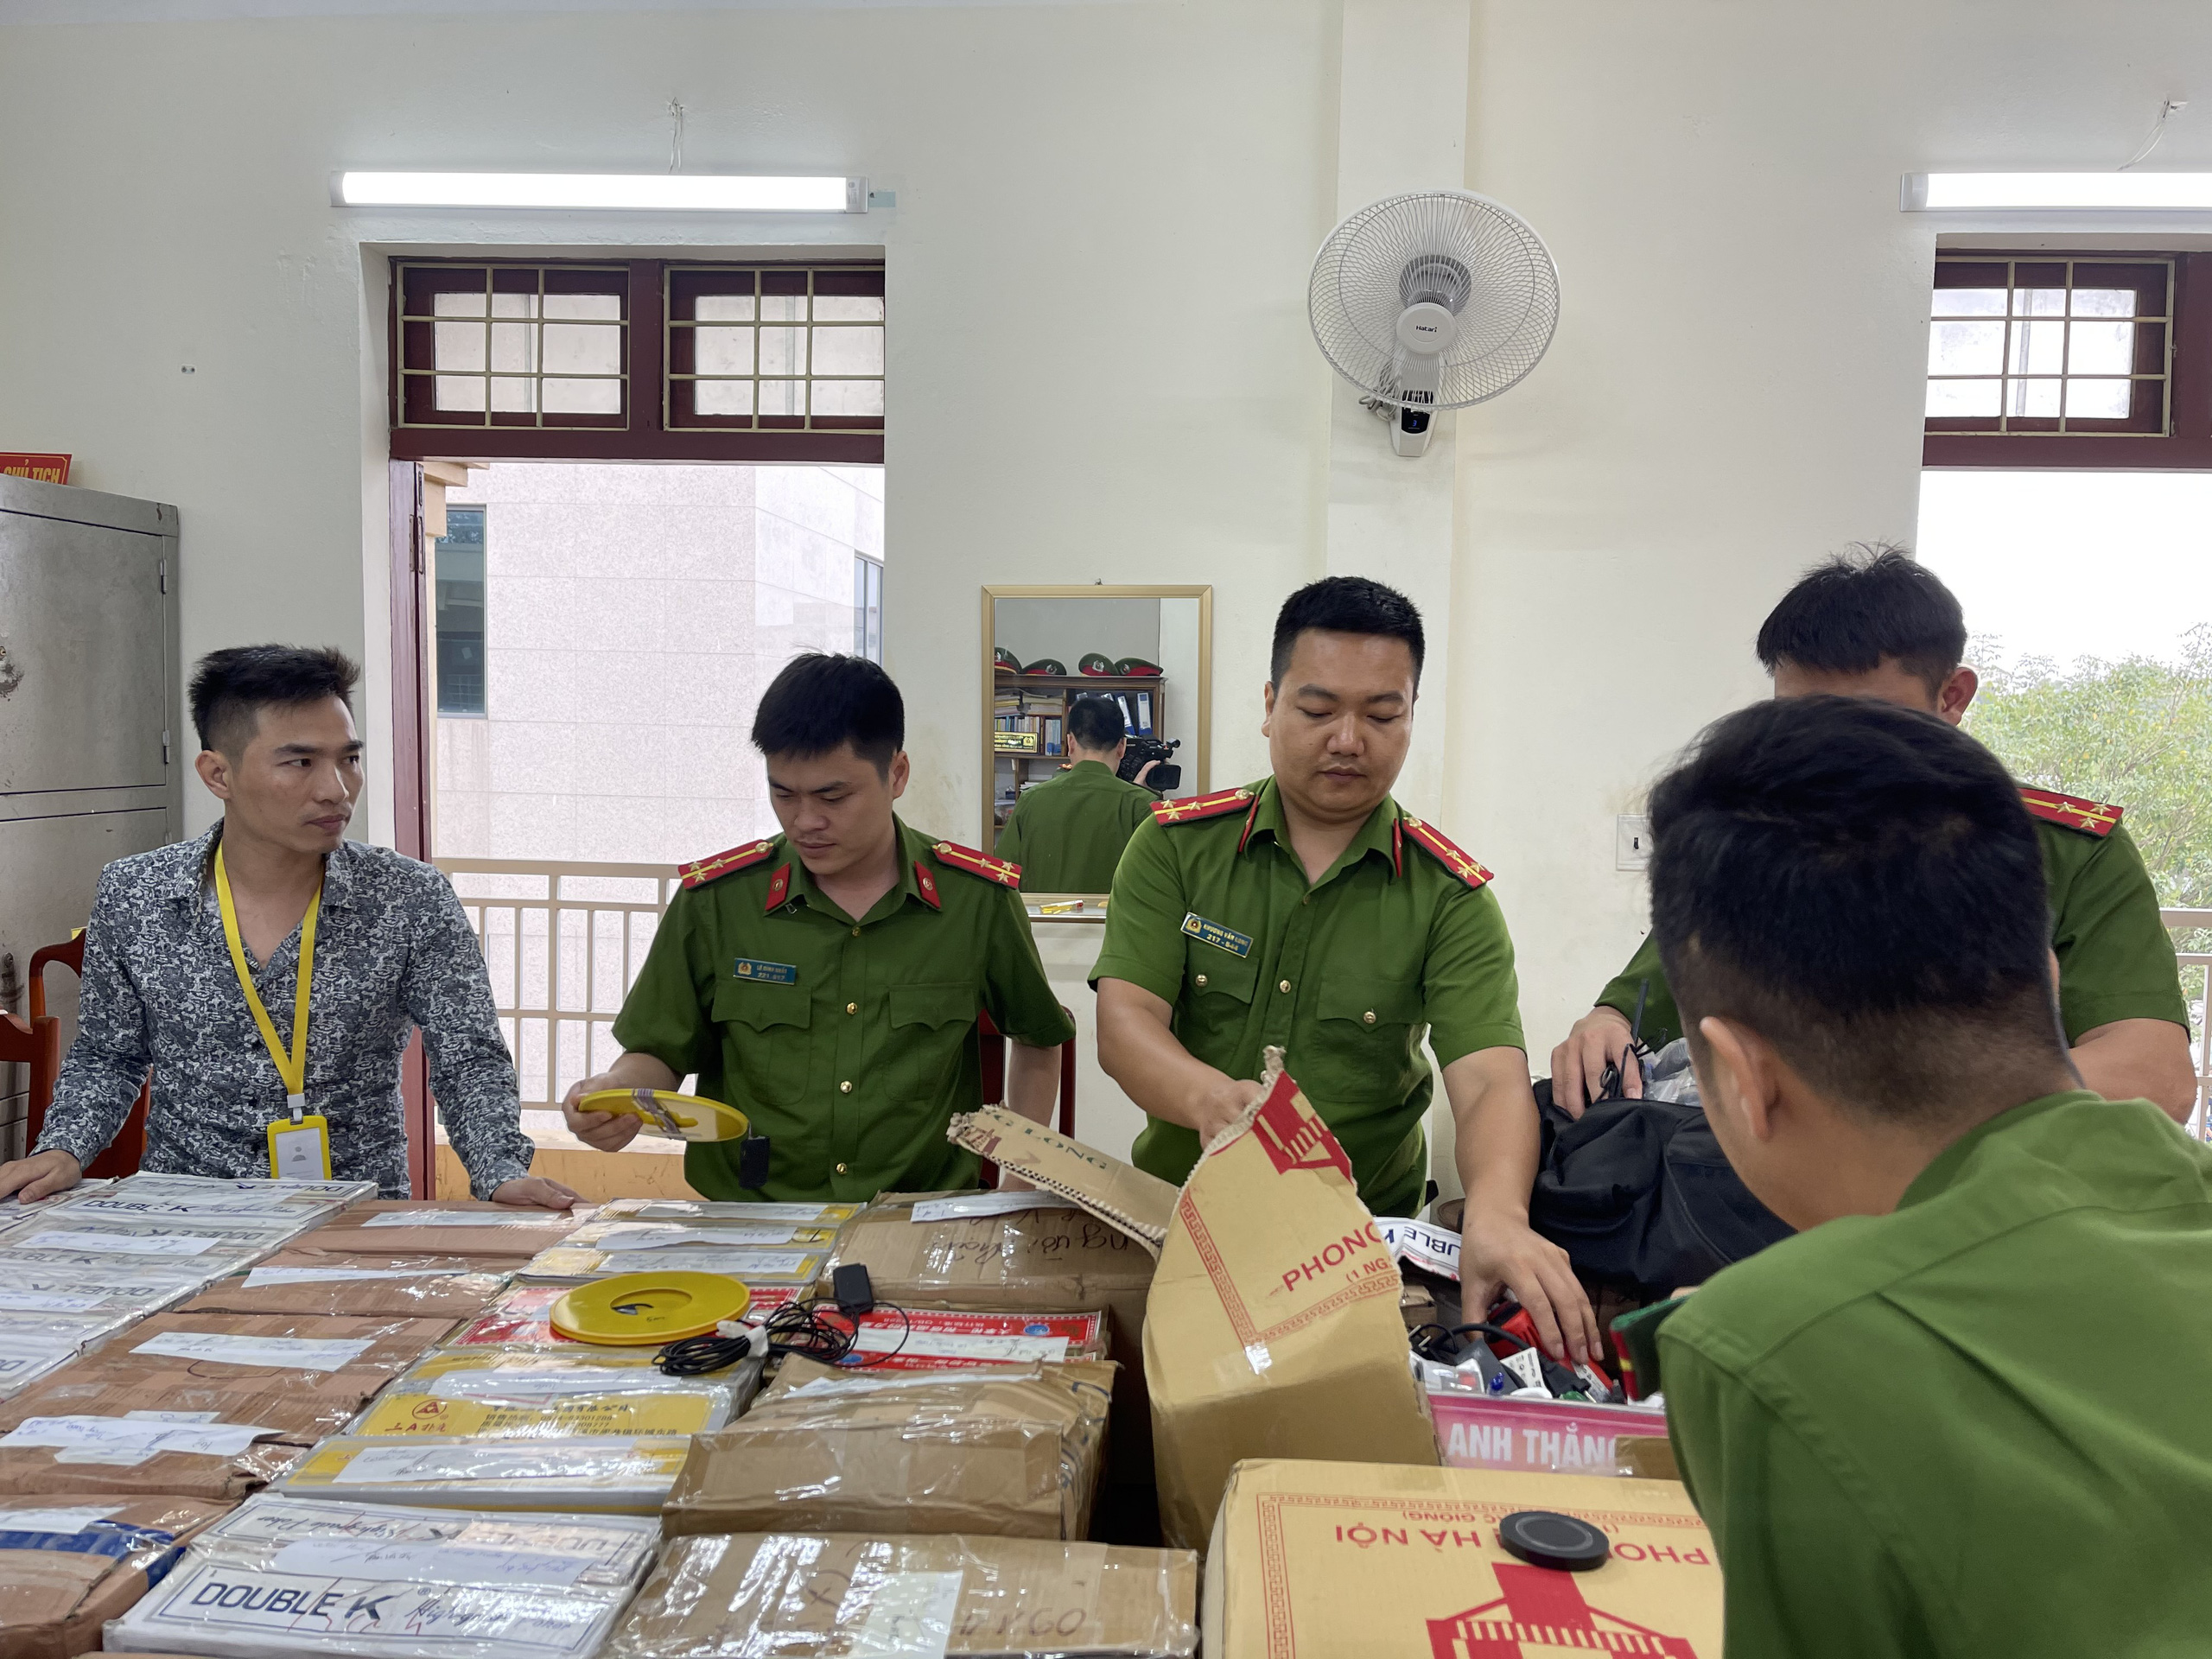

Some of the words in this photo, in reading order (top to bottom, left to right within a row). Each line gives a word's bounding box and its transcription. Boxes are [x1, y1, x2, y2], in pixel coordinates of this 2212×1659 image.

[1403, 1226, 1461, 1256] UBLE
[1447, 1422, 1512, 1462] ANH
[1335, 1521, 1408, 1549] NỘI
[1609, 1542, 1711, 1567] PHO
[190, 1582, 345, 1617] DOUBLE
[343, 1594, 396, 1620] K
